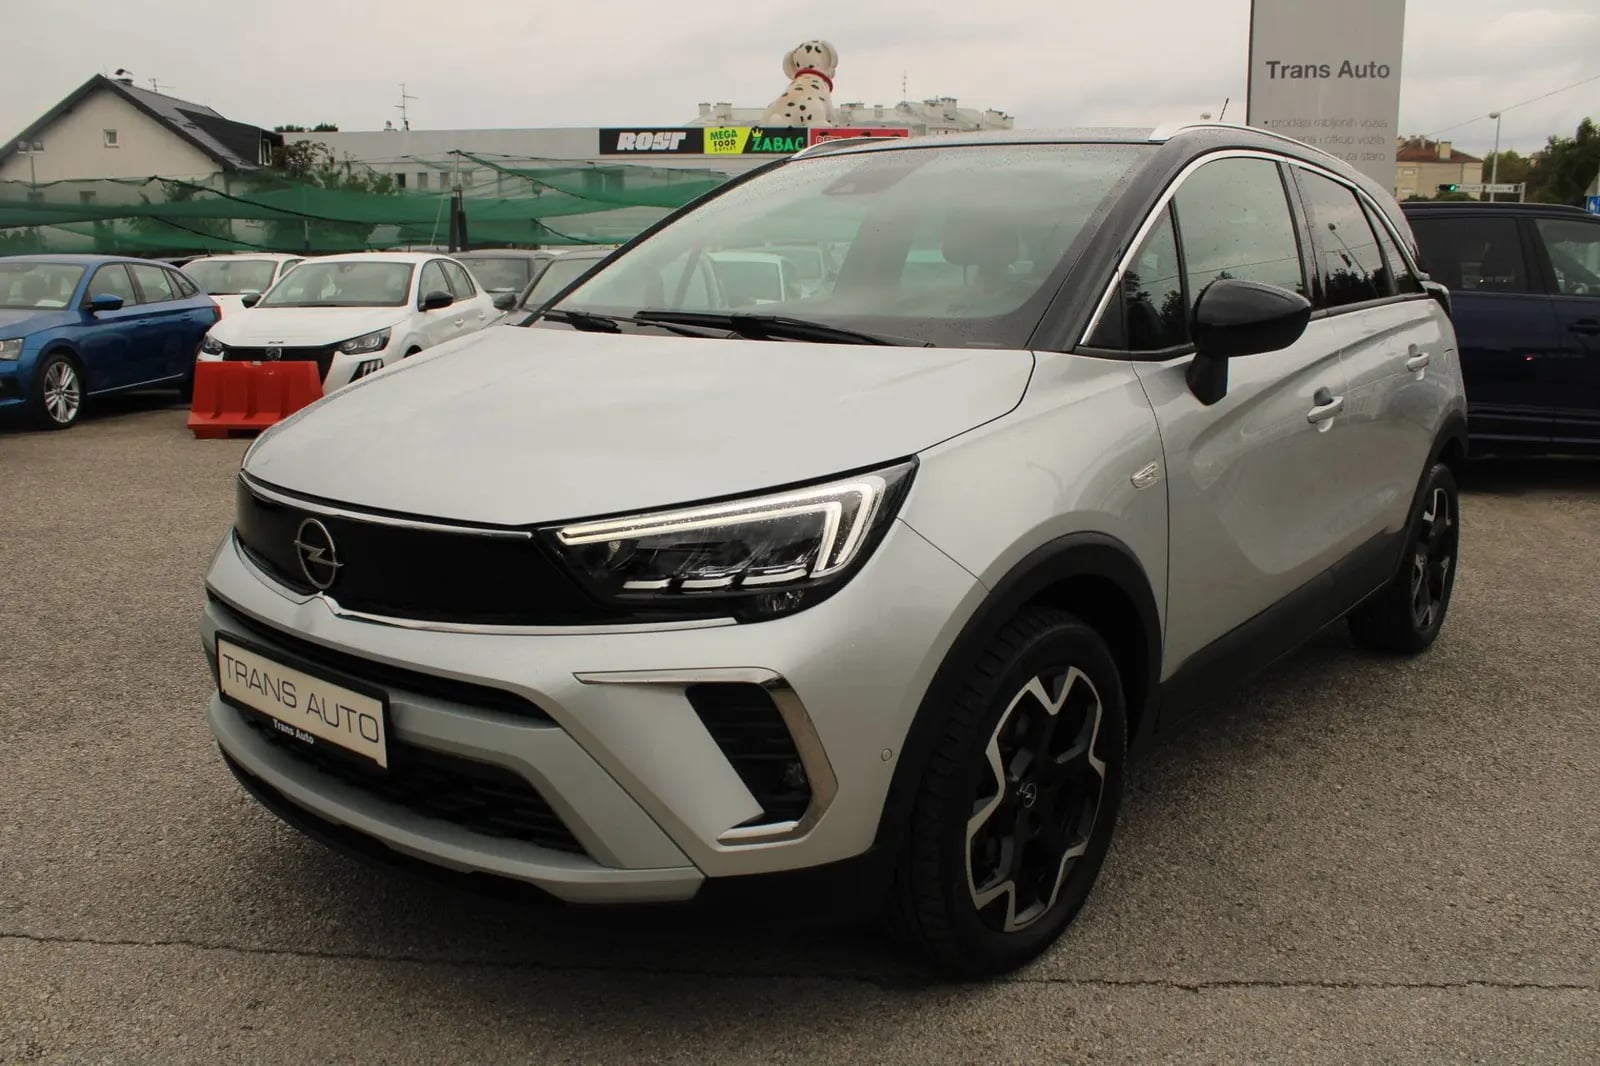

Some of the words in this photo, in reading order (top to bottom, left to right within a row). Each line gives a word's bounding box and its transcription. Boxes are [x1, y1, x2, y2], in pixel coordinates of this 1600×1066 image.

[1265, 60, 1331, 79] Trans
[1337, 59, 1390, 79] Auto
[616, 132, 687, 150] ROST
[710, 129, 738, 140] MEGA
[713, 139, 736, 147] FOOD
[222, 653, 297, 709] TRANS
[306, 692, 379, 743] AUTO
[272, 718, 295, 736] Trans
[295, 728, 314, 744] Auto
